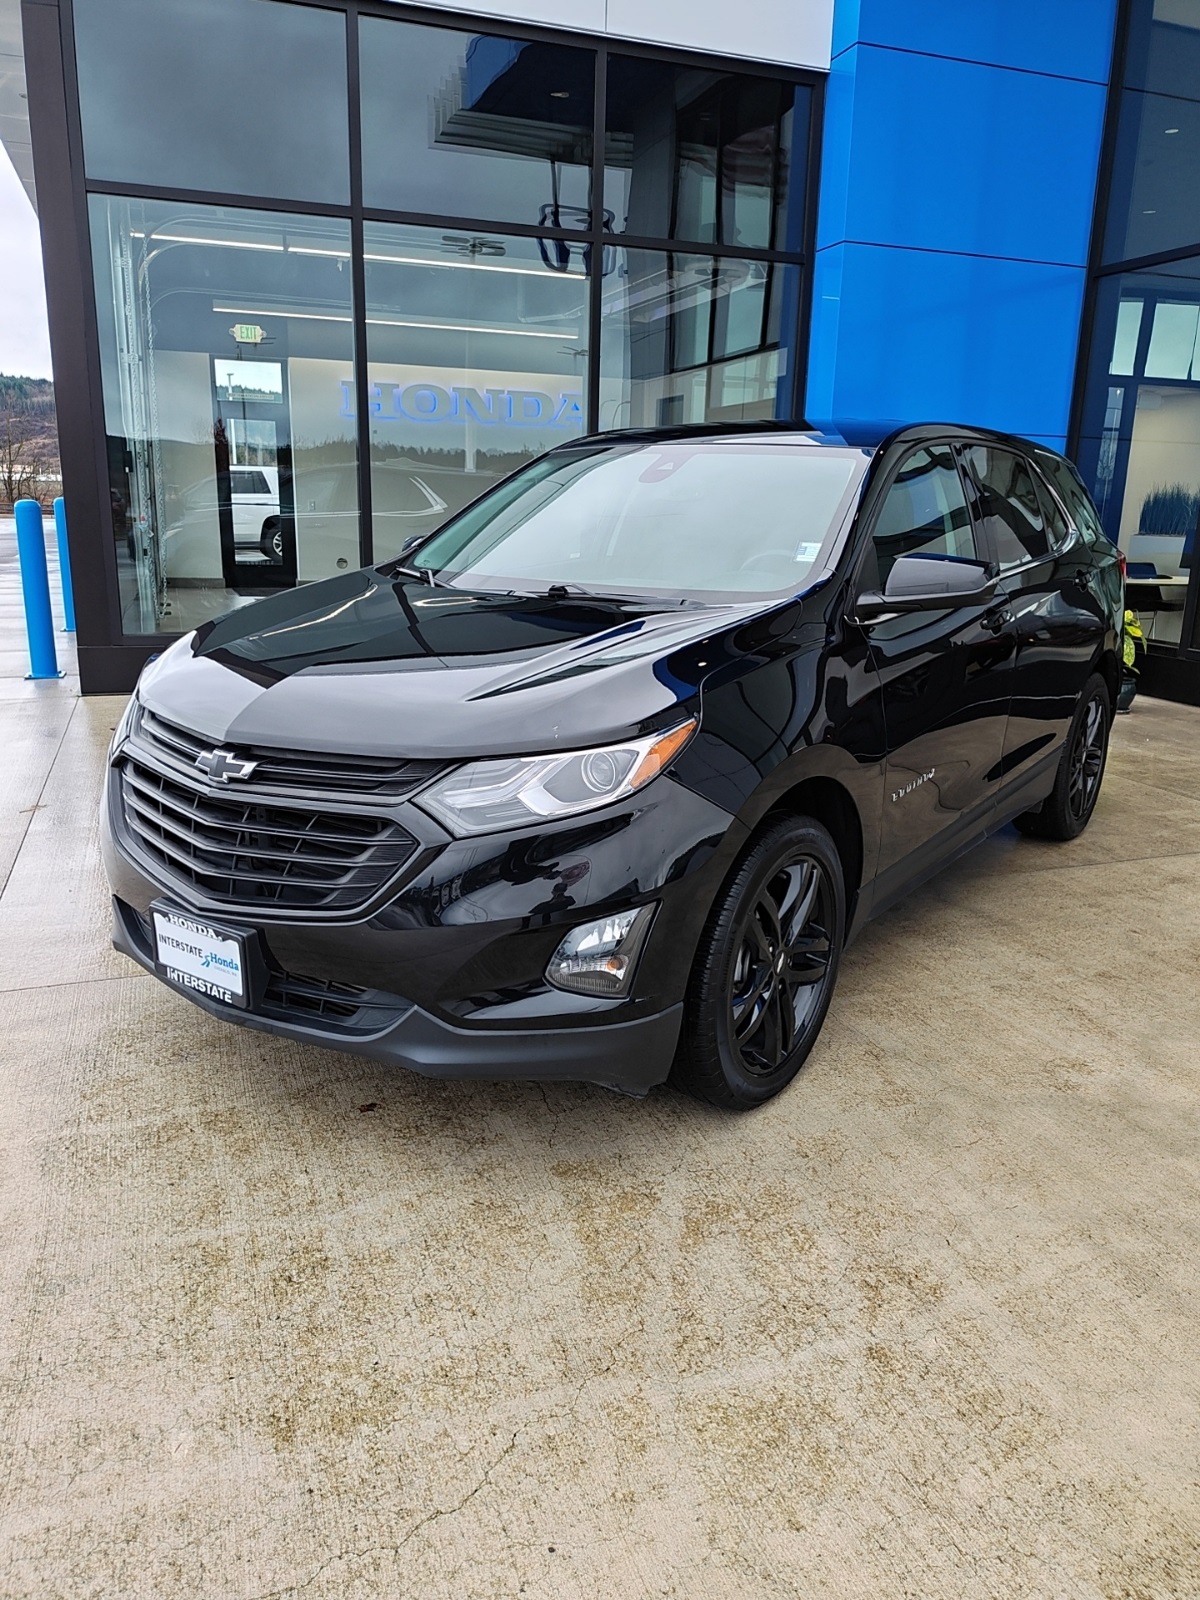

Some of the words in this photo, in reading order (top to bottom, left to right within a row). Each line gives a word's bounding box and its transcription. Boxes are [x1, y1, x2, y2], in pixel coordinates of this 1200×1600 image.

[240, 326, 257, 340] EXIT
[168, 914, 217, 939] HONDA
[158, 933, 203, 958] INTERSTATE
[209, 952, 239, 971] Honda
[166, 967, 232, 1003] INTERSTATE
